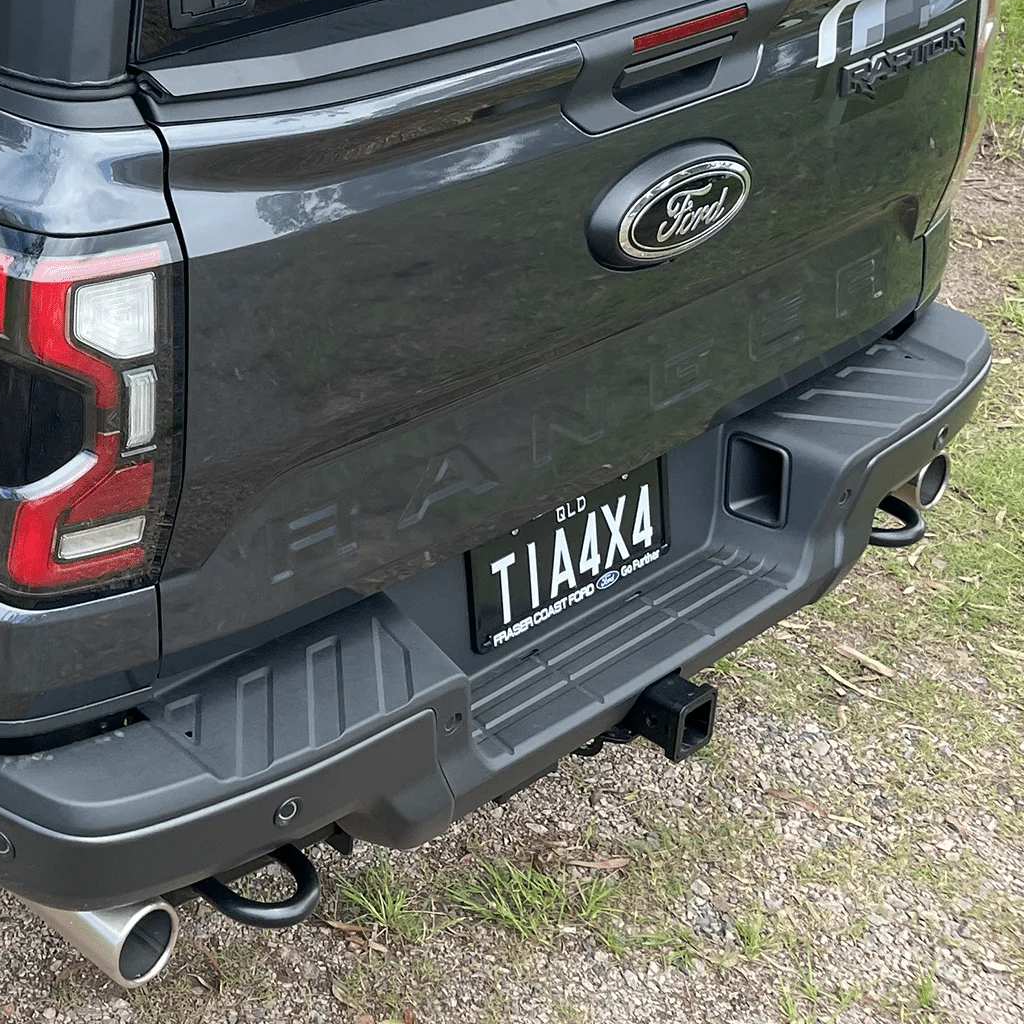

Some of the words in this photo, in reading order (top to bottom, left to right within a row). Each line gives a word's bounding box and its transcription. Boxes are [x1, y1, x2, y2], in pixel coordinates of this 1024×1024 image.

[837, 17, 966, 100] RAPTOR
[656, 182, 729, 243] Ford
[555, 495, 587, 523] QLD
[493, 616, 534, 647] FRASER
[533, 597, 568, 625] COAST
[568, 583, 595, 606] FORD
[620, 564, 633, 577] Go
[632, 549, 660, 571] Further
